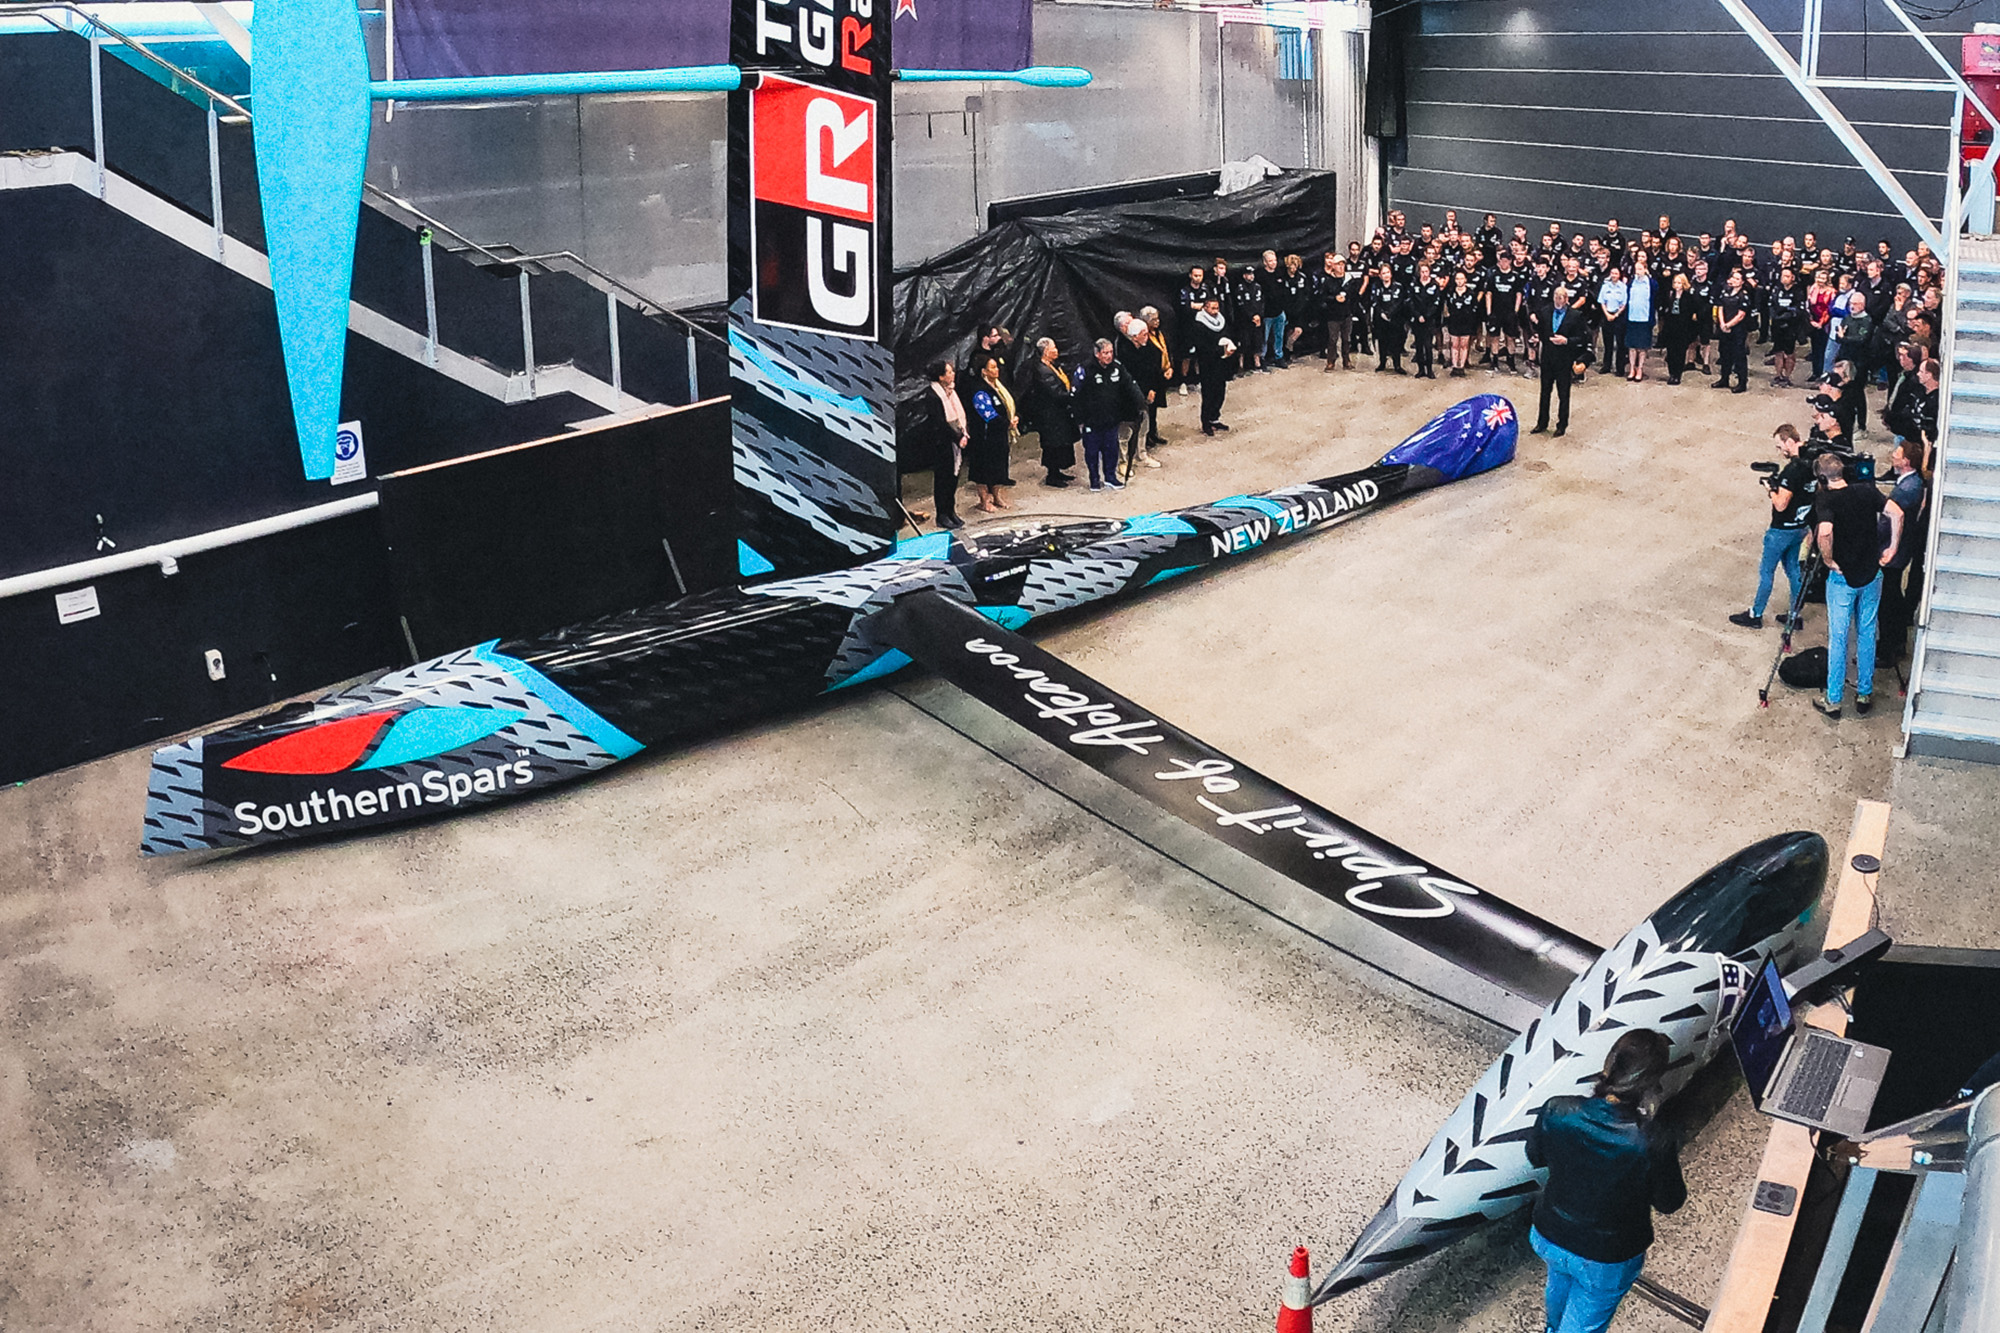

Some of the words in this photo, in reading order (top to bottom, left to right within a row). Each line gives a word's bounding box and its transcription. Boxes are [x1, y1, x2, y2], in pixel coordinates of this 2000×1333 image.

[756, 0, 792, 55] T
[805, 96, 871, 328] GR
[1210, 516, 1271, 558] NEW
[1275, 479, 1380, 536] ZEALAND
[964, 637, 1165, 755] Aotearoa
[1154, 757, 1241, 795] of
[1195, 794, 1480, 919] Spirit
